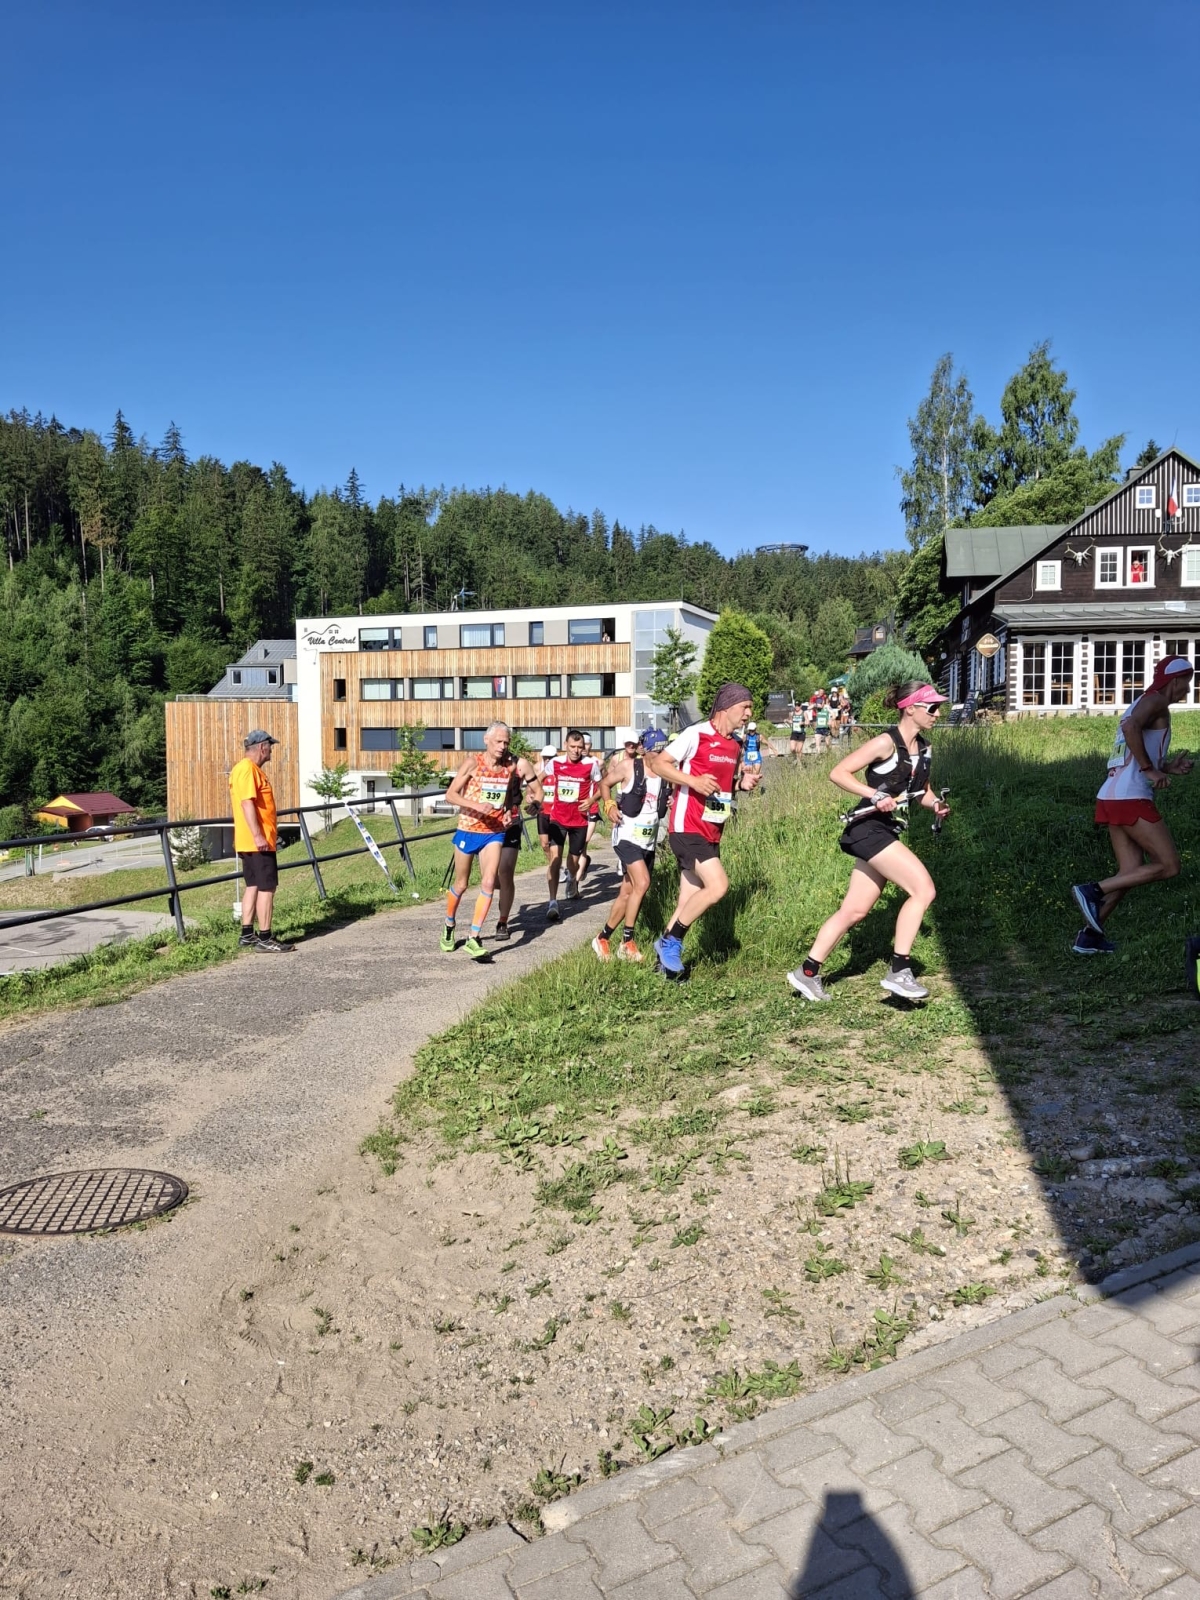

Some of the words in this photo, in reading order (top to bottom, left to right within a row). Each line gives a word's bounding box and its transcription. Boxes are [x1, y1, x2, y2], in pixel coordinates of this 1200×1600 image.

[307, 636, 326, 645] Villa
[328, 636, 356, 645] Central
[486, 792, 501, 800] 339
[561, 788, 574, 796] 977
[711, 802, 725, 811] 559
